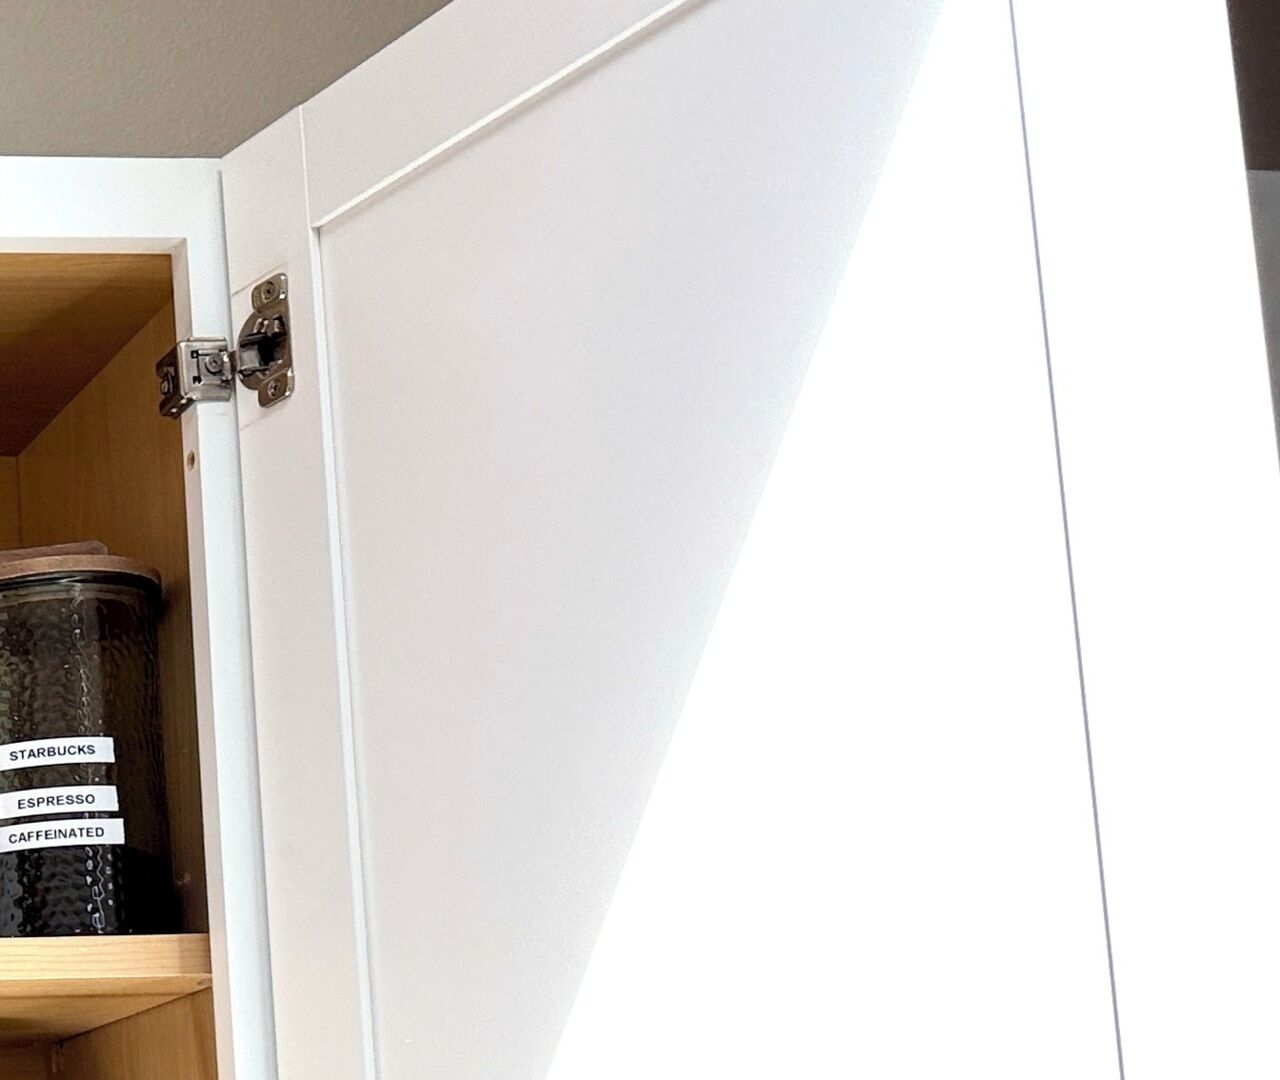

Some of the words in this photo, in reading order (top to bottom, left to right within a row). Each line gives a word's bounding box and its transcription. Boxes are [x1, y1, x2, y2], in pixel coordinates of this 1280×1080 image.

[9, 744, 96, 761] STARBUCKS
[17, 794, 96, 810] ESPRESSO
[8, 827, 105, 844] CAFFEINATED
